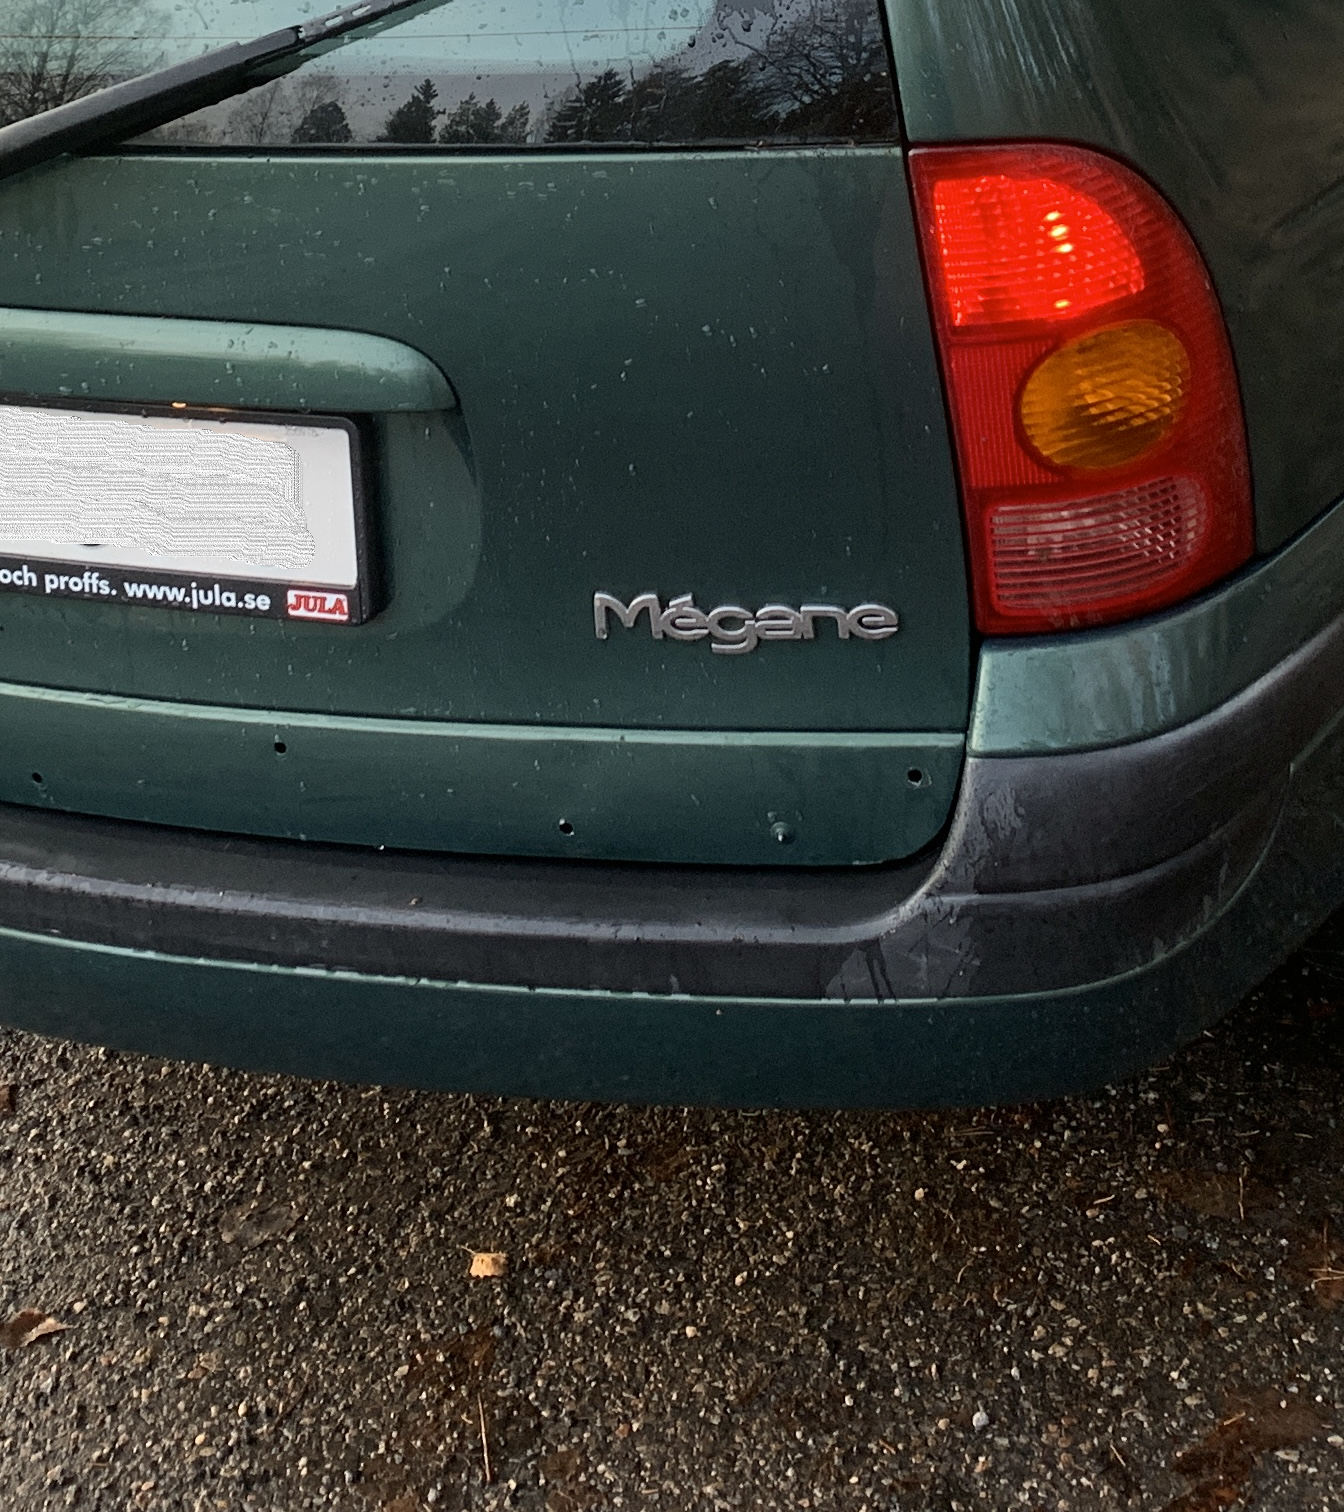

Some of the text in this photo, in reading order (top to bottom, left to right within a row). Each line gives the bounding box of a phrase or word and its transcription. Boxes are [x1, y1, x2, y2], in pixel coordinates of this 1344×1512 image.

[44, 571, 118, 596] proffs.
[123, 581, 272, 611] www.jula.se
[286, 594, 349, 616] JULA
[593, 590, 899, 655] Mégane
